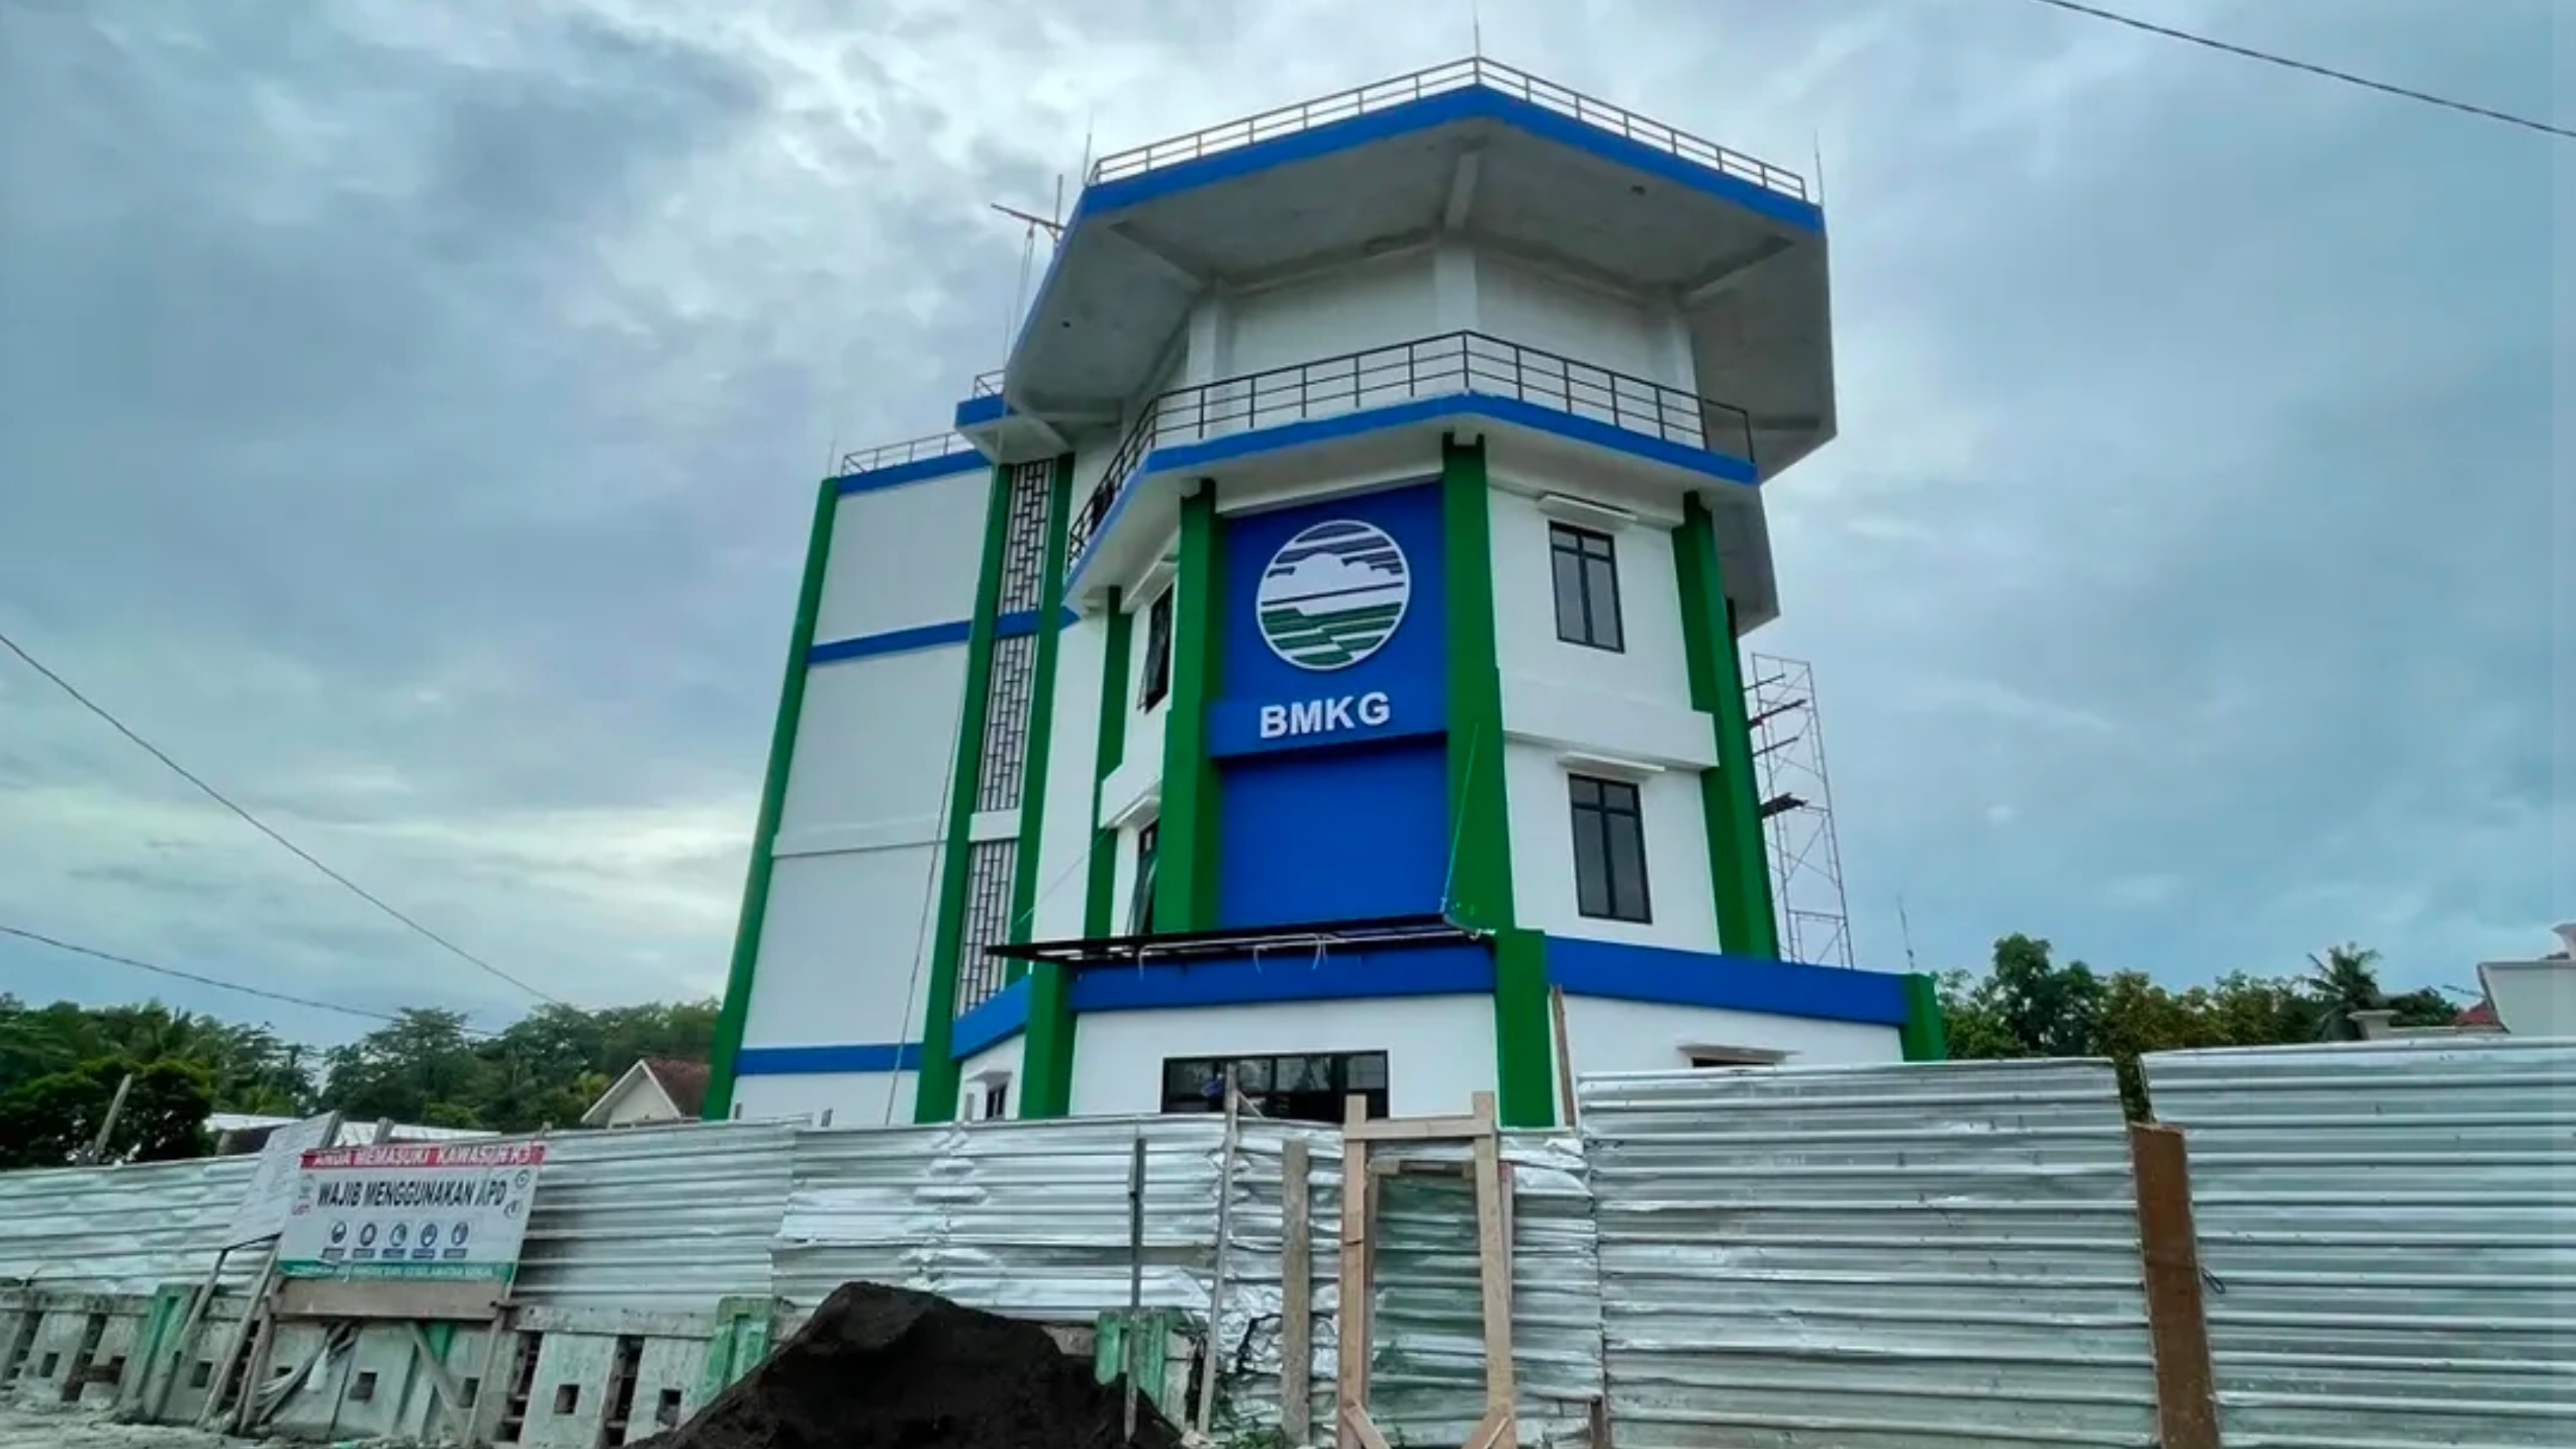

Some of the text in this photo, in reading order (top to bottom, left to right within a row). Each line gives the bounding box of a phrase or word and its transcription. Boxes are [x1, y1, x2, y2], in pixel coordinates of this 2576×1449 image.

[1260, 691, 1391, 739] BMKG
[355, 1147, 429, 1166] MEMASUKI
[317, 1180, 507, 1207] WAJIB MENGGUNAKAN APD
